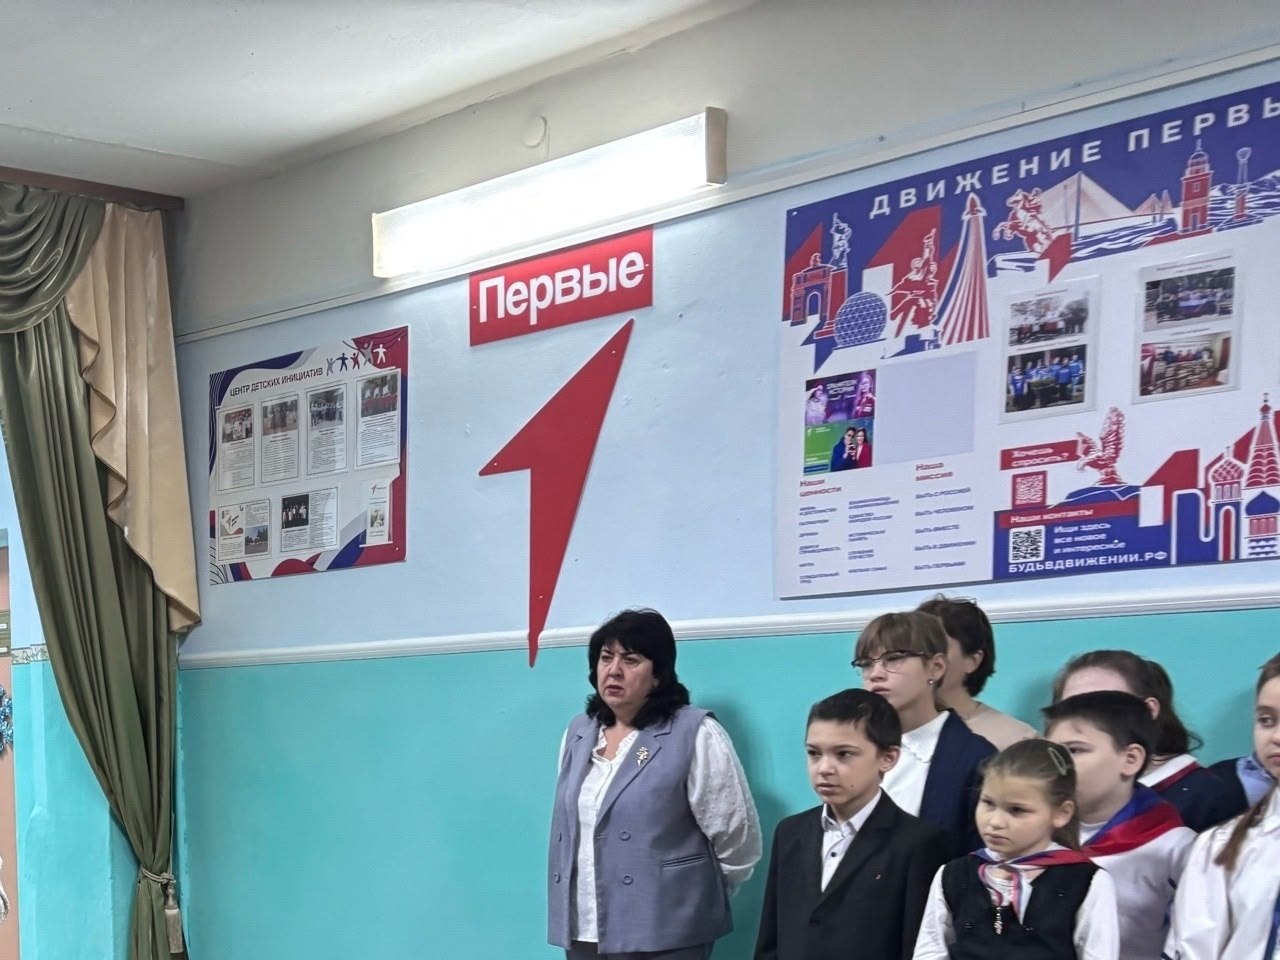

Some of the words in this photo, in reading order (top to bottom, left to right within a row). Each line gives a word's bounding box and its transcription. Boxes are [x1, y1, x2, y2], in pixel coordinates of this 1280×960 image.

[869, 140, 1103, 219] ДВИЖЕНИЕ
[478, 250, 645, 325] Первые
[230, 384, 251, 397] ЦЕНТР
[251, 377, 280, 392] ДЕТСКИХ
[281, 367, 323, 384] ИНИЦИАТИВ
[1008, 551, 1168, 573] БУДЬВДВИЖЕНИИ.РФ
